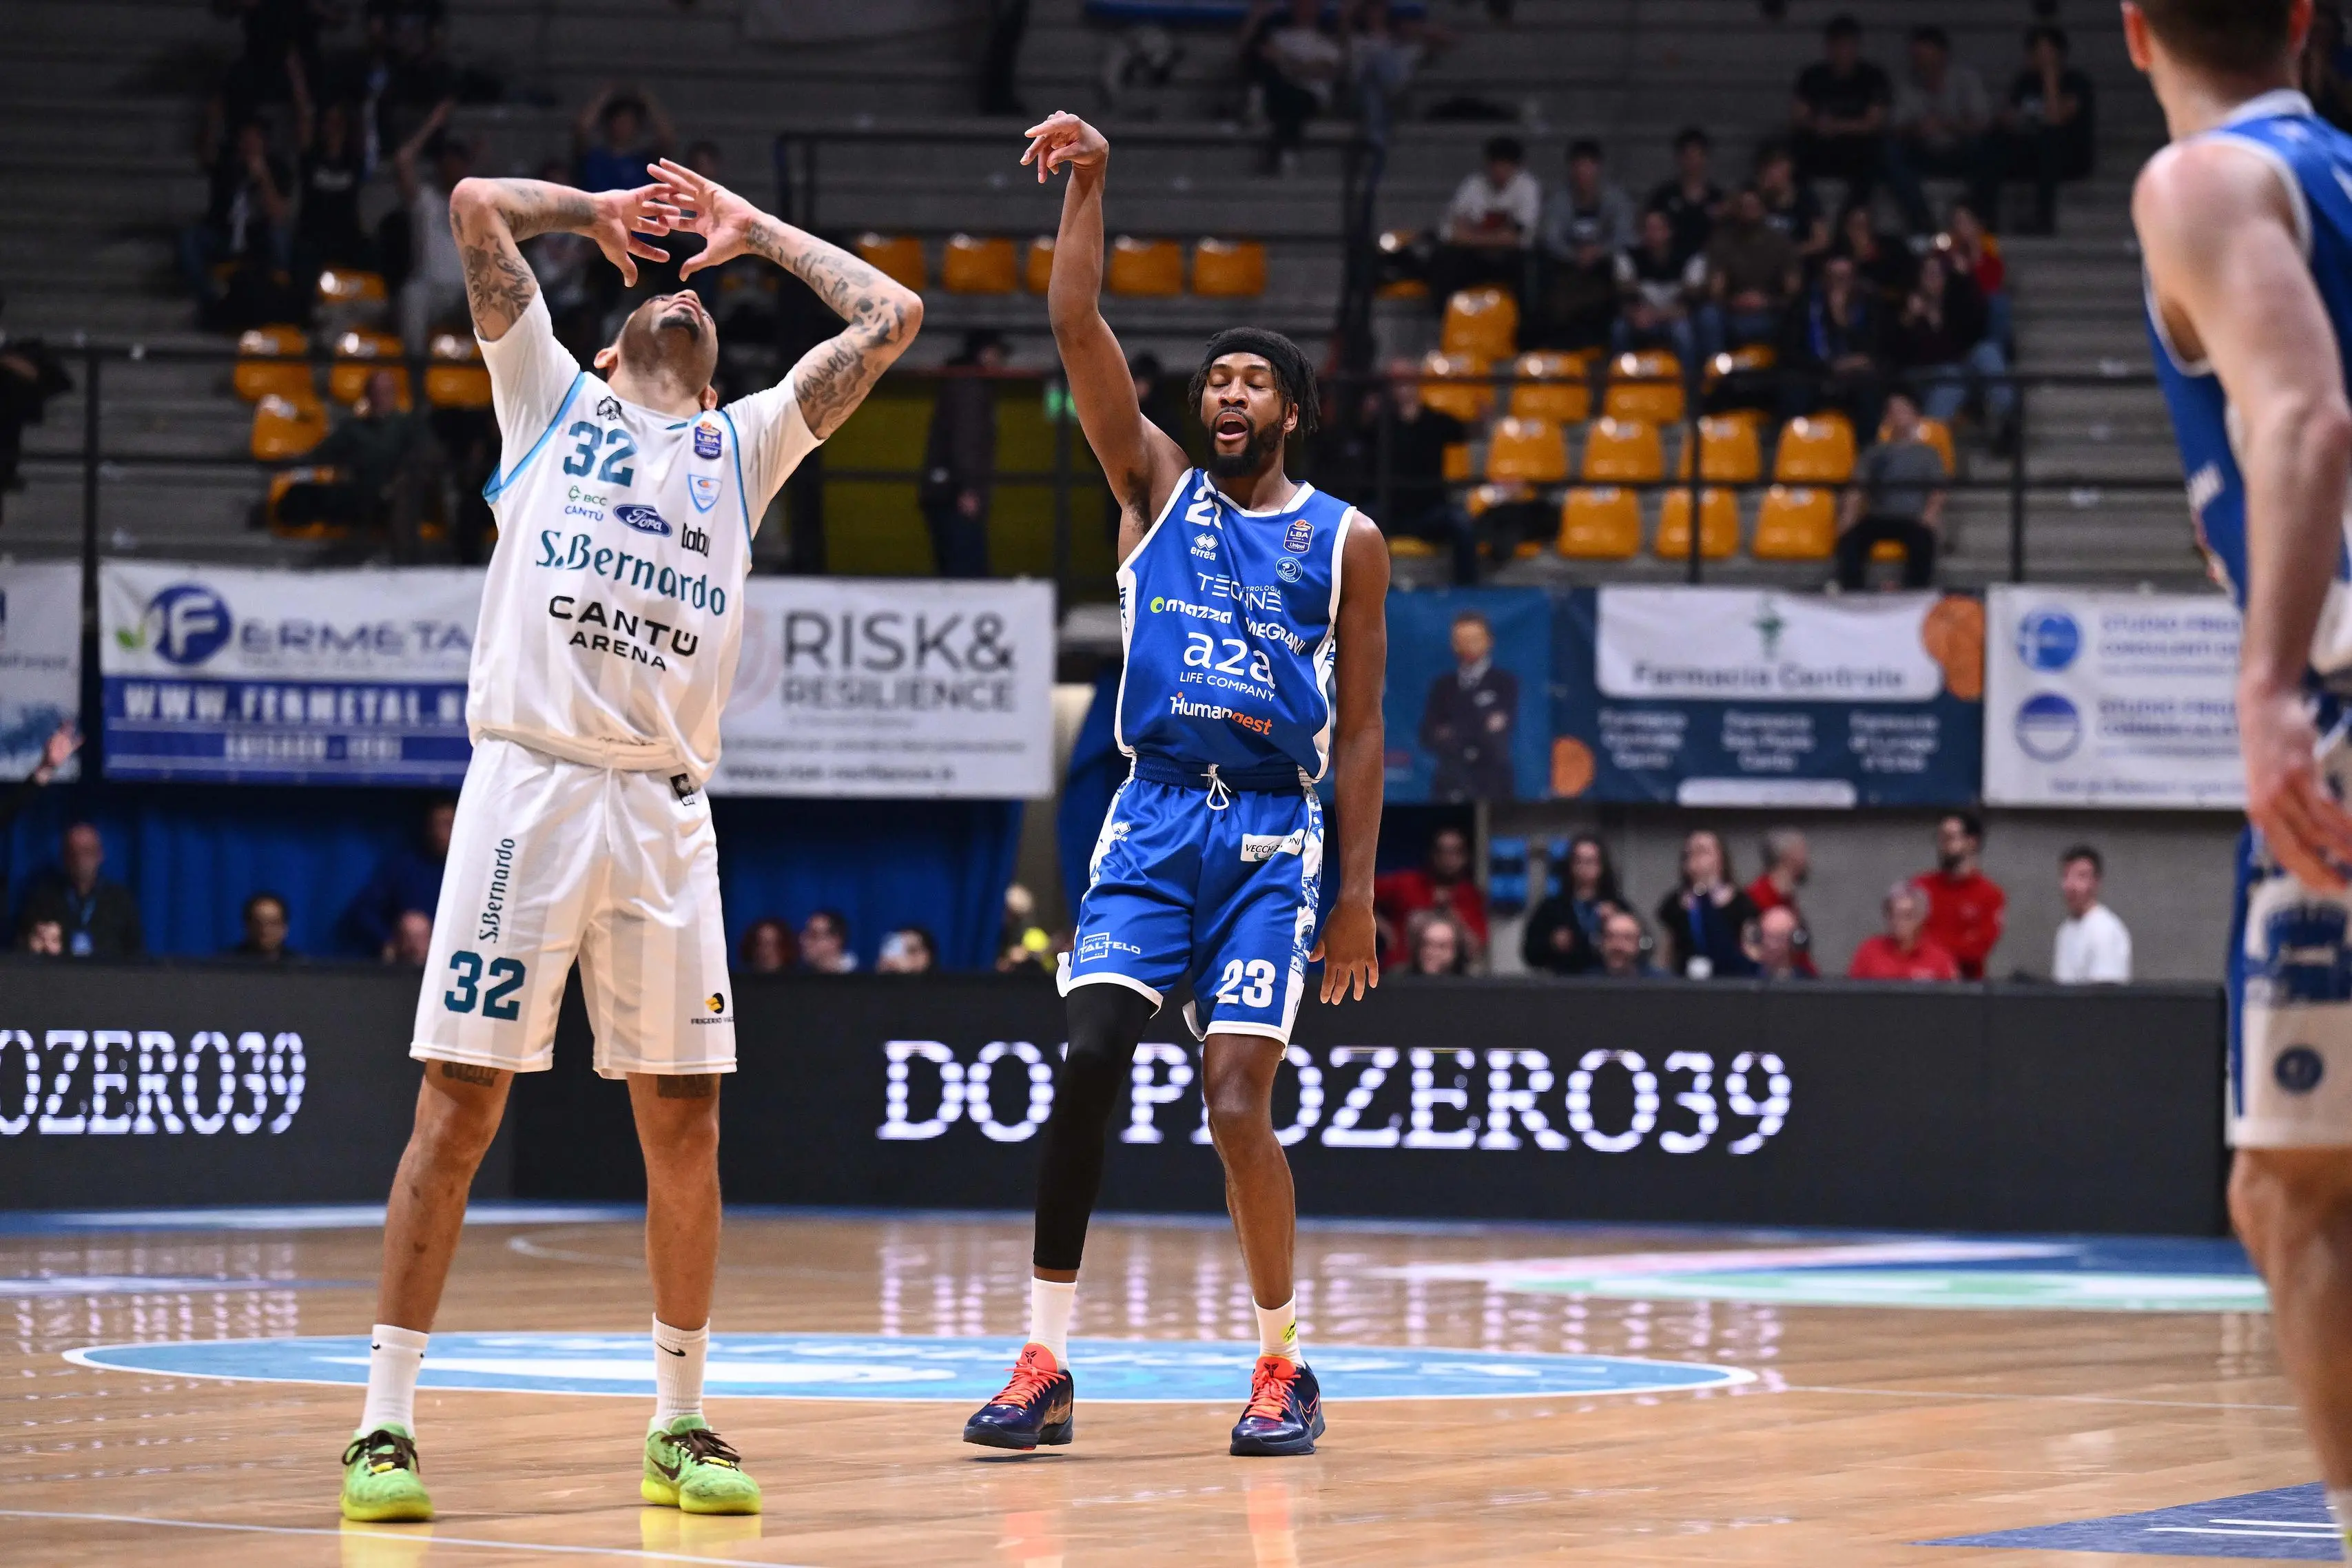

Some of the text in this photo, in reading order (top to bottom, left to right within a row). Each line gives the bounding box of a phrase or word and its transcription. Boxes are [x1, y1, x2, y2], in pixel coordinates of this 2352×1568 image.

[563, 421, 638, 487] 32
[564, 506, 604, 522] CANTÙ
[584, 495, 608, 506] BCC
[626, 508, 663, 531] Ford
[1289, 530, 1308, 538] LBA
[1289, 541, 1306, 550] Unipol
[535, 530, 726, 617] S.Bernardo
[1241, 585, 1281, 596] ETROLOGIA
[548, 595, 699, 657] CANTÙ
[783, 610, 1015, 672] RISK&
[569, 631, 667, 672] ARENA
[1183, 632, 1276, 689] a2a
[782, 674, 1015, 712] RESILIENCE
[1179, 672, 1275, 702] LIFE COMPANY
[1634, 662, 1905, 688] Farmacia Centrale
[479, 837, 516, 945] S.Bernardo
[1077, 940, 1142, 957] ITALTELO
[1085, 936, 1106, 945] GRUPPO
[444, 950, 526, 1021] 32
[1217, 959, 1276, 1009] 23
[875, 1040, 1792, 1156] DOPOZERO39
